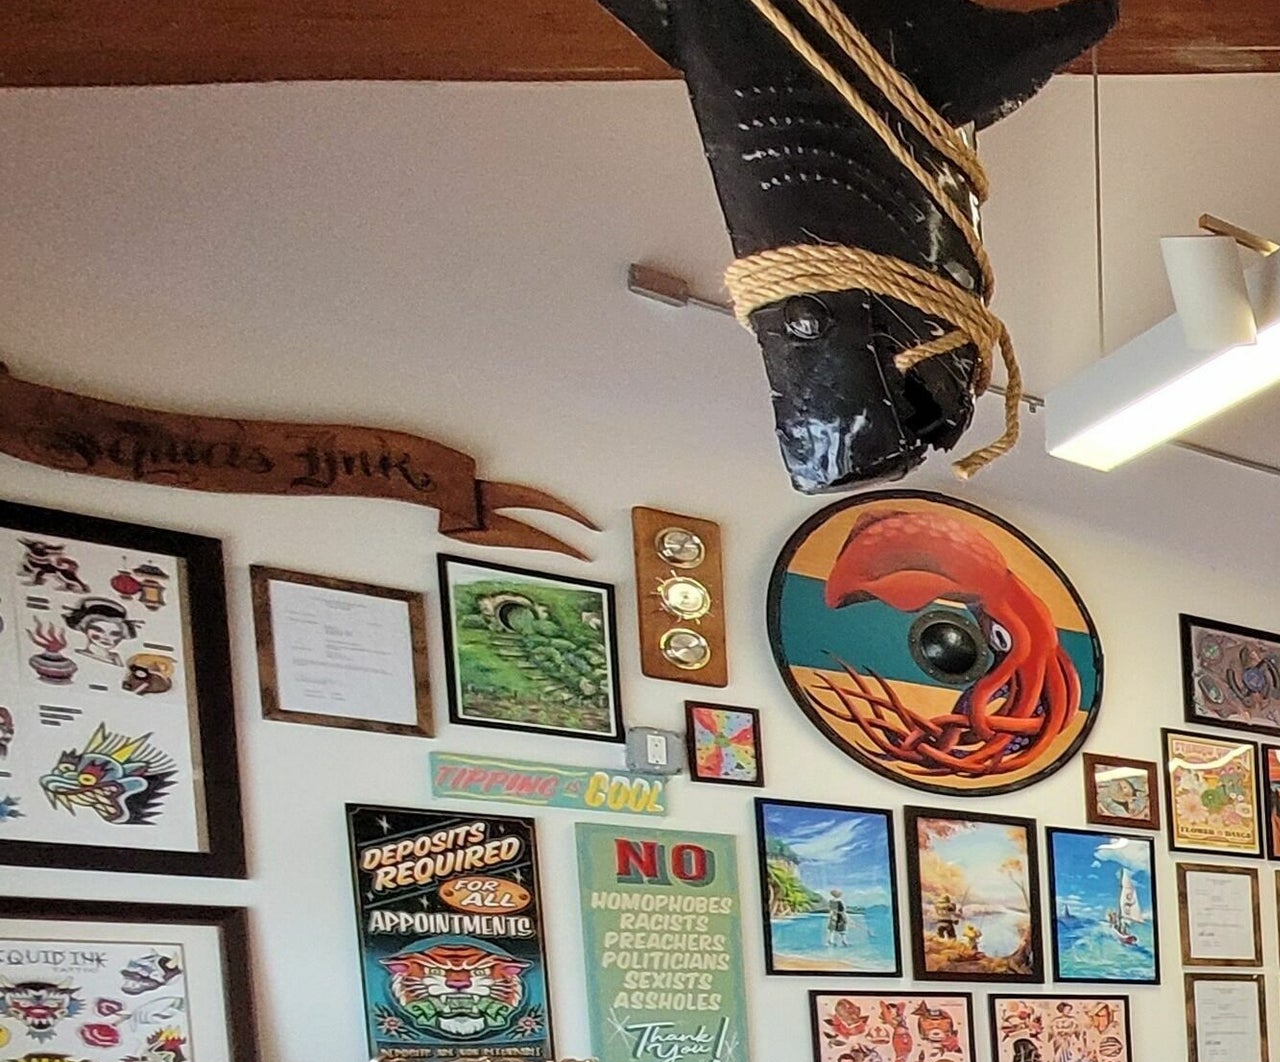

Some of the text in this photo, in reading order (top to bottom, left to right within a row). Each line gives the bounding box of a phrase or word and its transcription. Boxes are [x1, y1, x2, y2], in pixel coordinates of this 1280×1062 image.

[433, 765, 559, 797] TIPPING
[585, 771, 665, 813] COOL
[362, 822, 486, 871] DEPOSITS
[374, 836, 521, 891] REQUIRED
[614, 836, 712, 885] NO
[454, 880, 500, 892] FOR
[460, 893, 516, 908] ALL
[590, 891, 733, 915] HOMOPHOBES
[368, 910, 535, 937] APPOINTMENTS
[619, 912, 710, 932] RACISTS
[603, 931, 726, 951] PREACHERS
[0, 949, 109, 968] QUID INK
[601, 950, 731, 971] POLITICIANS
[622, 970, 713, 990] SEXISTS
[612, 991, 723, 1011] ASSHOLES
[625, 1021, 714, 1059] Thank
